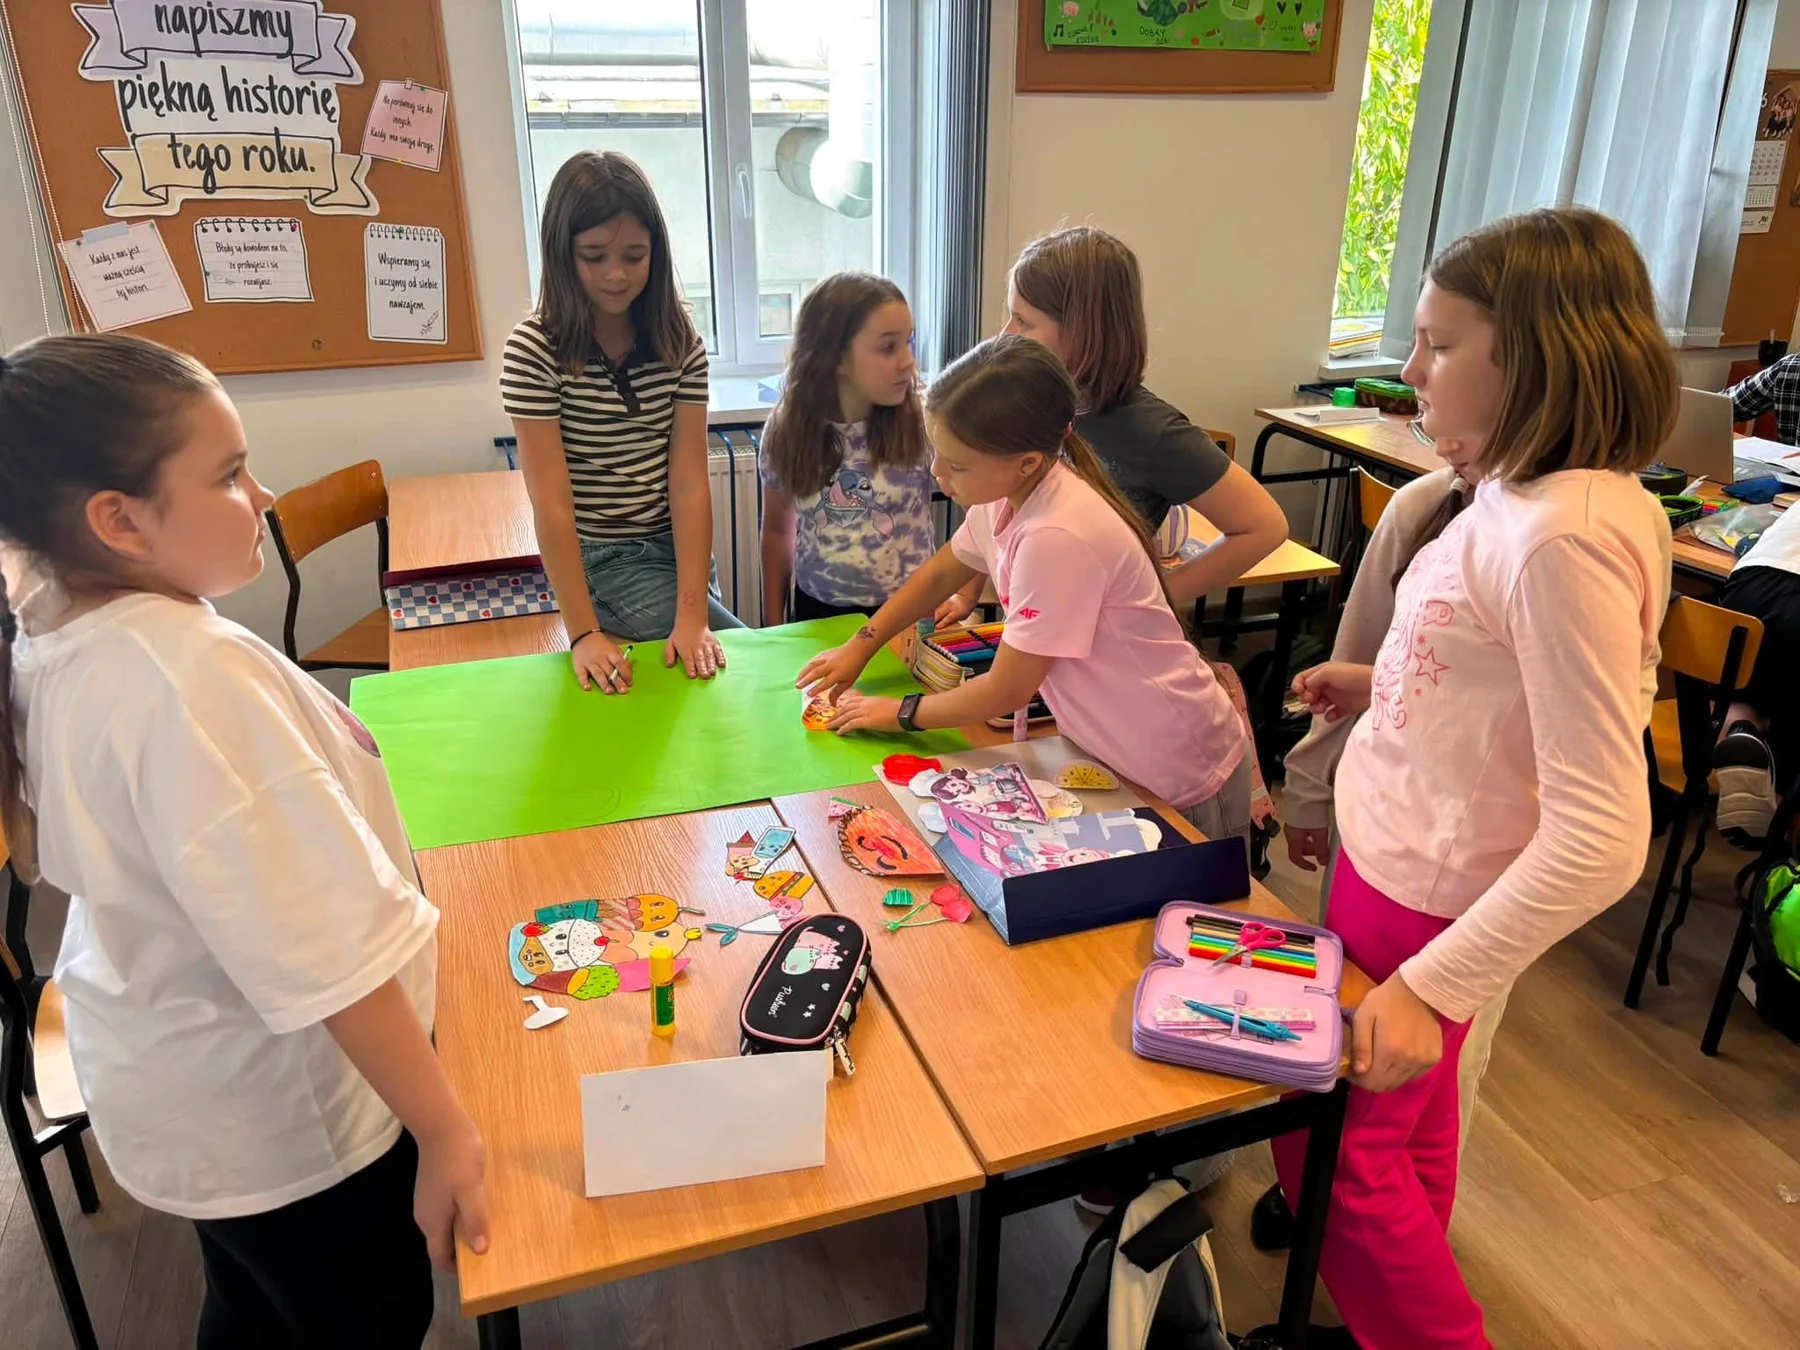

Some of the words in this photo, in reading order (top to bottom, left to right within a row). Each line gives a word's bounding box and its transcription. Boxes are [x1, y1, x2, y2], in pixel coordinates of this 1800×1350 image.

[154, 2, 294, 59] napiszmy
[118, 60, 218, 133] piękną
[221, 65, 337, 123] historię
[167, 133, 231, 194] tego
[242, 127, 316, 173] roku.
[89, 252, 112, 266] Każdy
[117, 250, 127, 259] nas
[127, 245, 140, 260] jest
[215, 241, 234, 256] Błędy
[234, 245, 242, 253] są
[243, 241, 270, 253] dowodem
[236, 259, 266, 273] próbujesz
[270, 261, 279, 270] się
[378, 252, 419, 272] Wspieramy
[421, 258, 431, 269] się
[379, 278, 406, 292] uczymy
[408, 276, 417, 288] od
[419, 278, 439, 289] siebie
[1018, 607, 1041, 620] 4F
